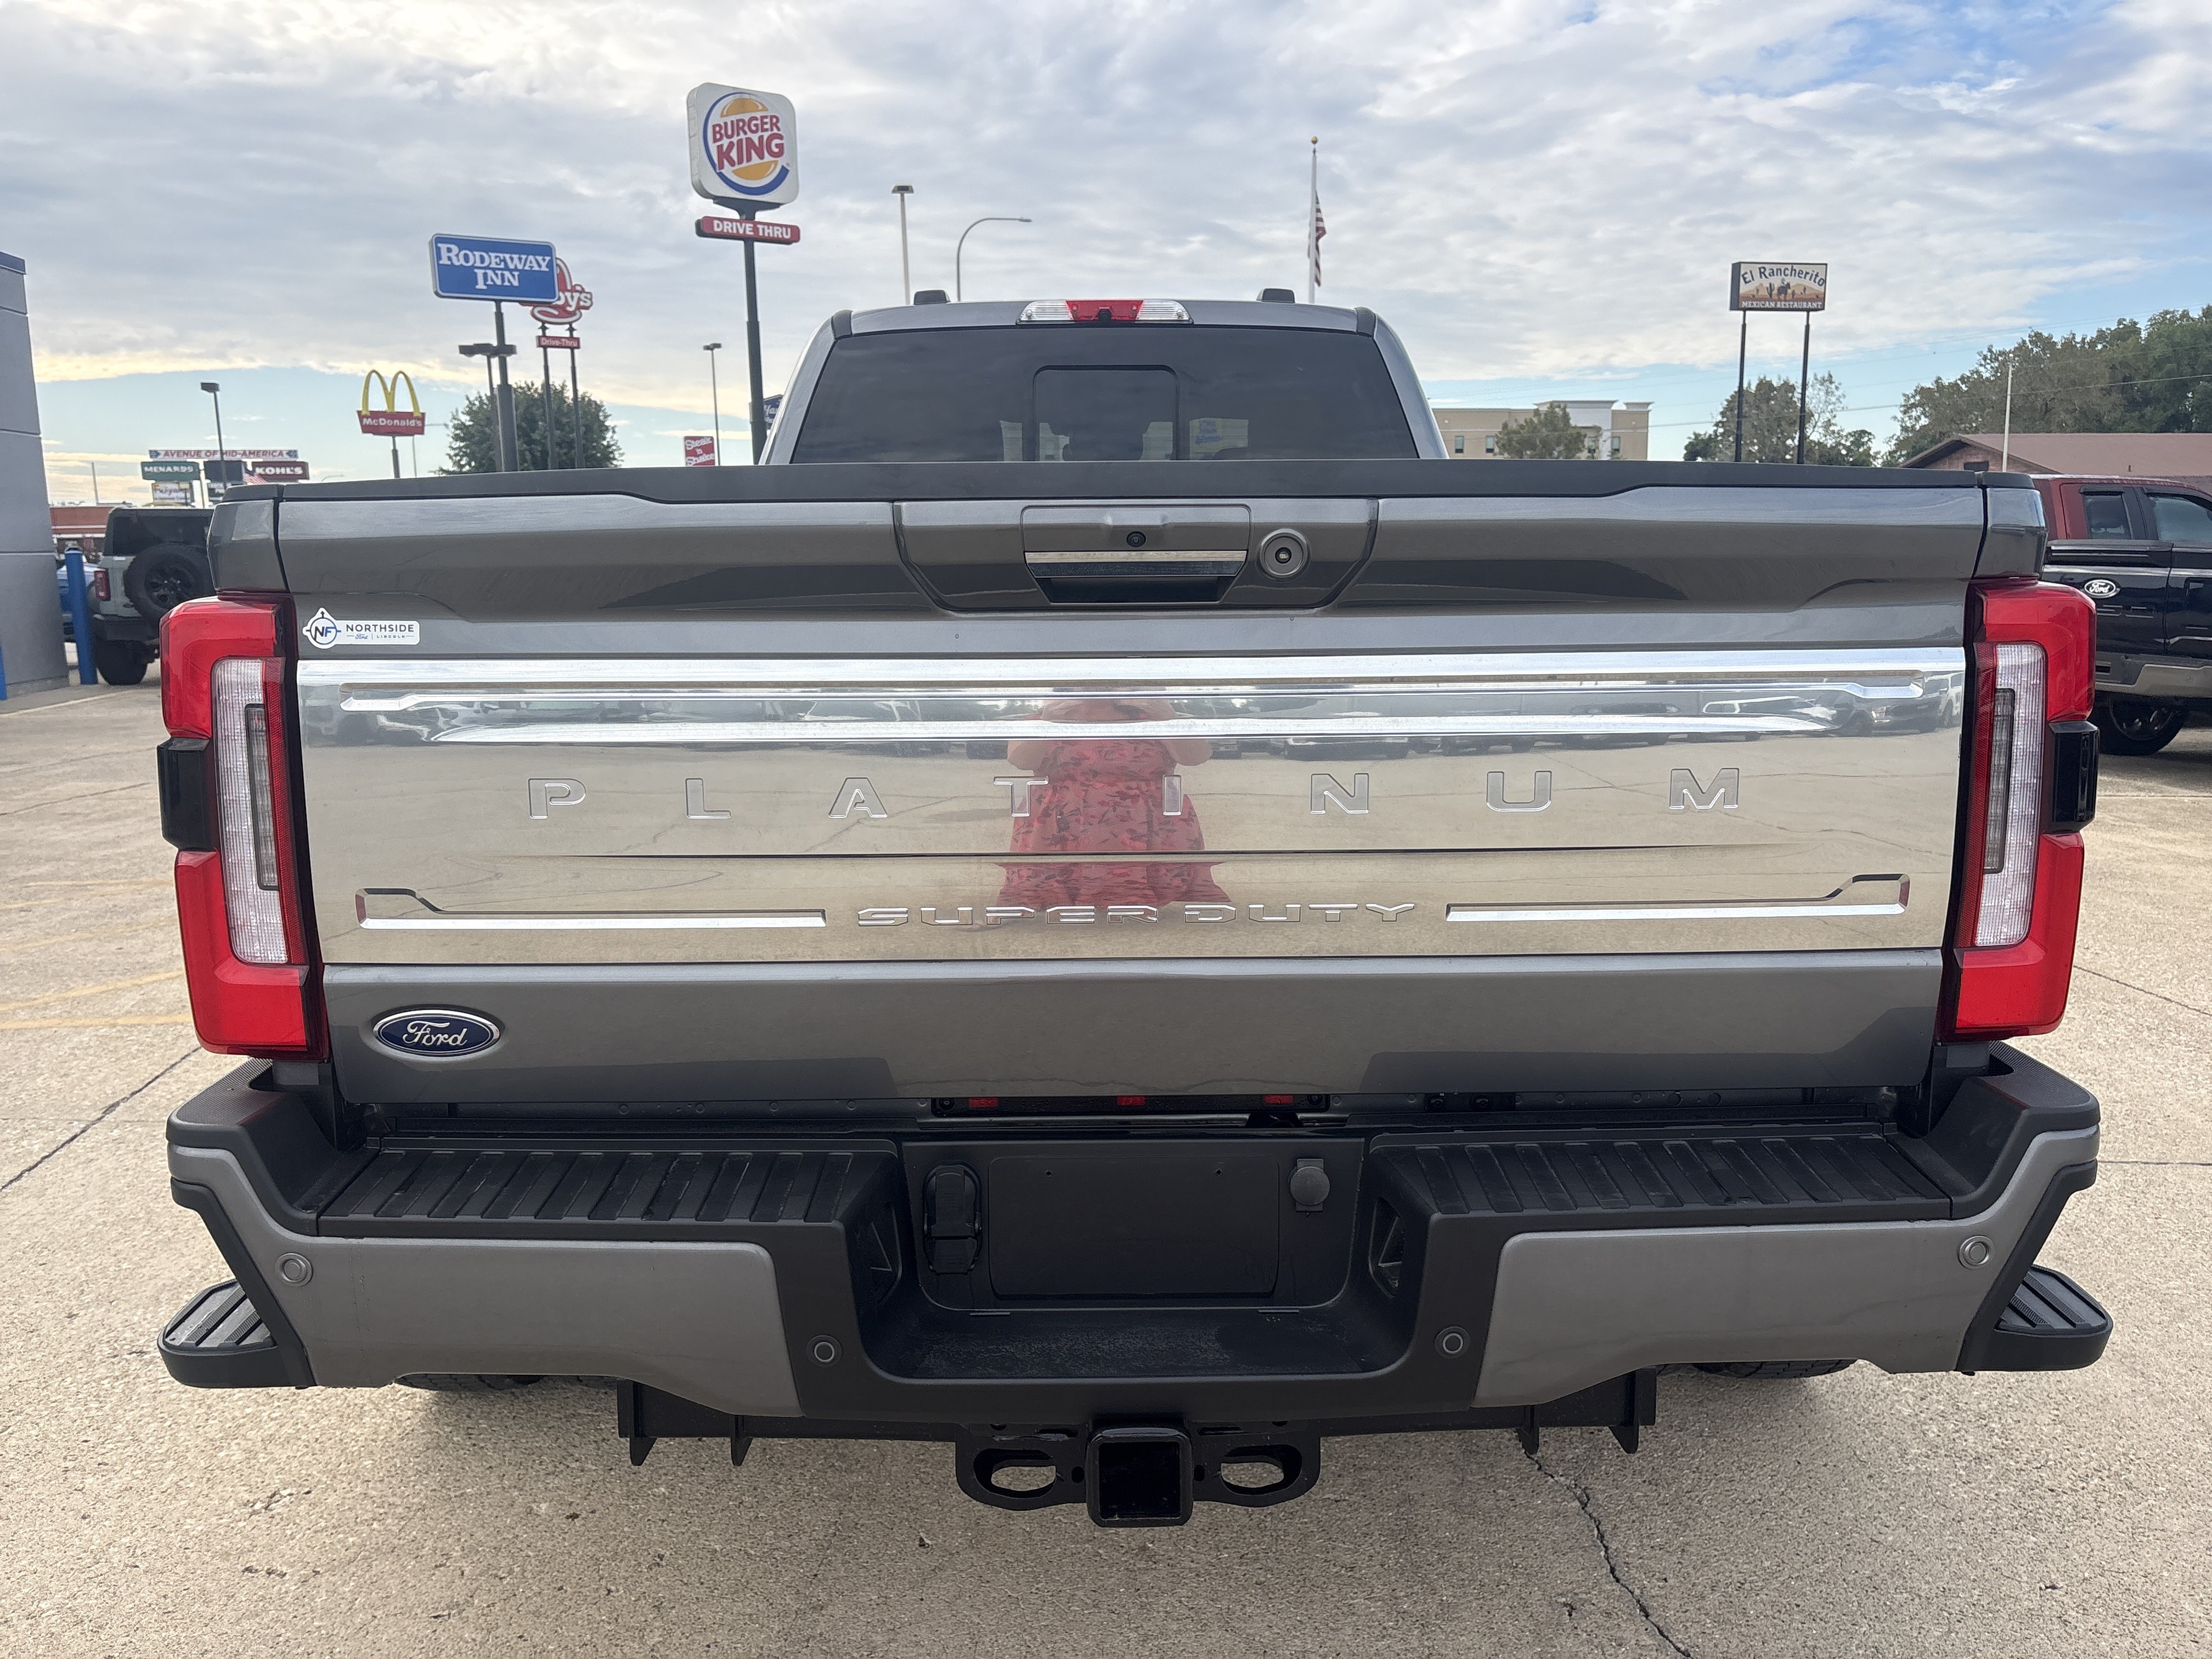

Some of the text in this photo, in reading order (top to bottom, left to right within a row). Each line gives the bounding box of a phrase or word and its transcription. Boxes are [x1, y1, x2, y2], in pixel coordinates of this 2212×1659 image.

[712, 115, 781, 144] BURGER
[716, 133, 785, 171] KING
[713, 220, 791, 239] DRIVE THRU
[438, 243, 551, 272] RODEWAY
[473, 269, 520, 290] INN
[1741, 264, 1825, 287] El Rancherito
[540, 337, 578, 347] Drive-Thru
[363, 417, 422, 426] McDonald's
[255, 466, 303, 475] KOHL'S
[2089, 582, 2110, 594] Ford
[346, 624, 414, 633] NORTHSIDE
[528, 767, 1740, 820] PLATINUM
[857, 902, 1415, 927] SUPER DUTY
[402, 1020, 468, 1046] Ford
